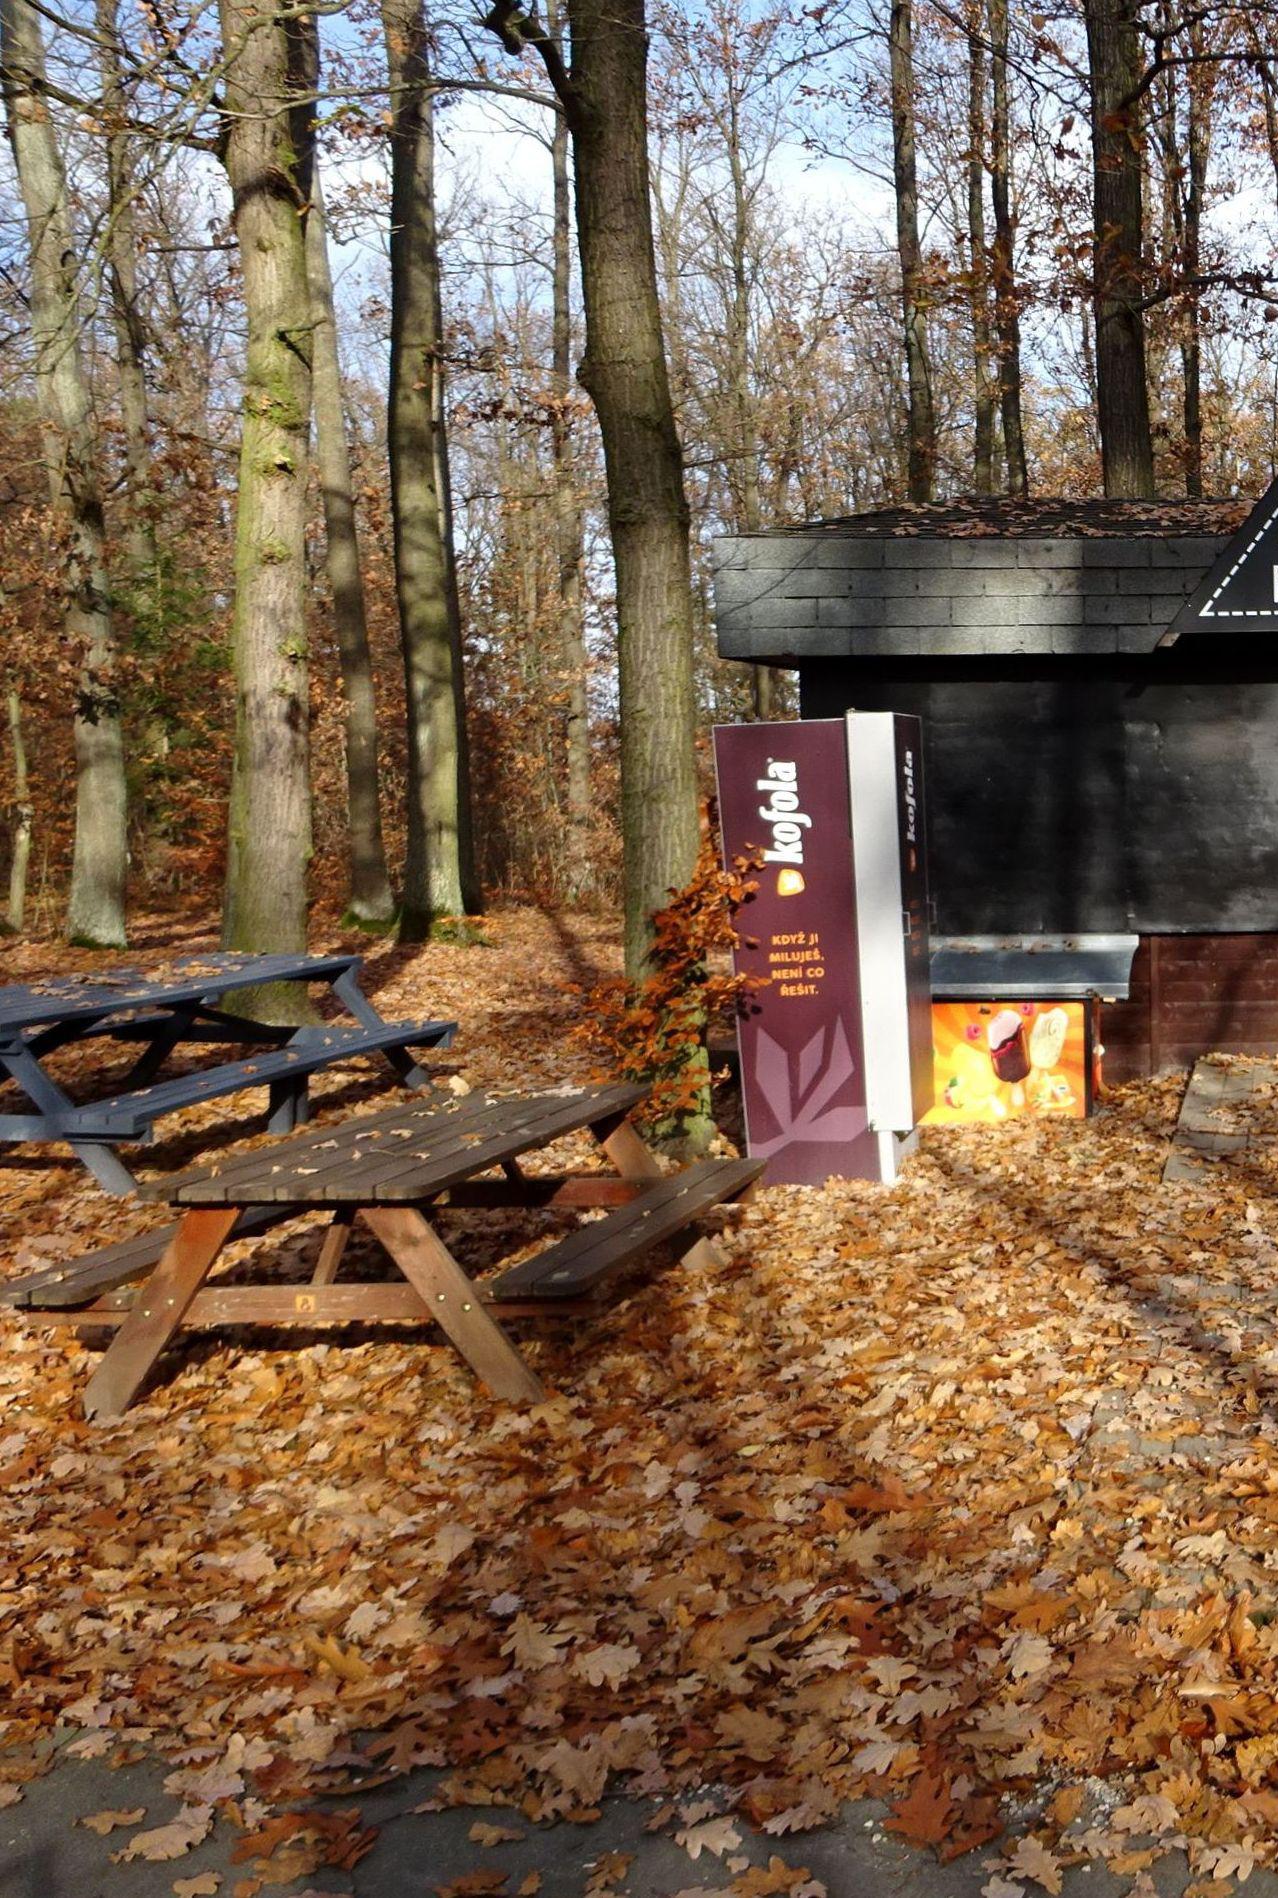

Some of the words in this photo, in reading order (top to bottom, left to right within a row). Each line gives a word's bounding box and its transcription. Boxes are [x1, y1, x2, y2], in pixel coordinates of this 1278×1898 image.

[904, 750, 917, 842] kofola
[757, 761, 813, 864] kofola
[771, 931, 806, 945] KDYŽ
[808, 933, 819, 945] JI
[771, 965, 803, 979] NENÍ
[806, 967, 825, 978] CO
[780, 982, 819, 996] ŘEŠIT.
